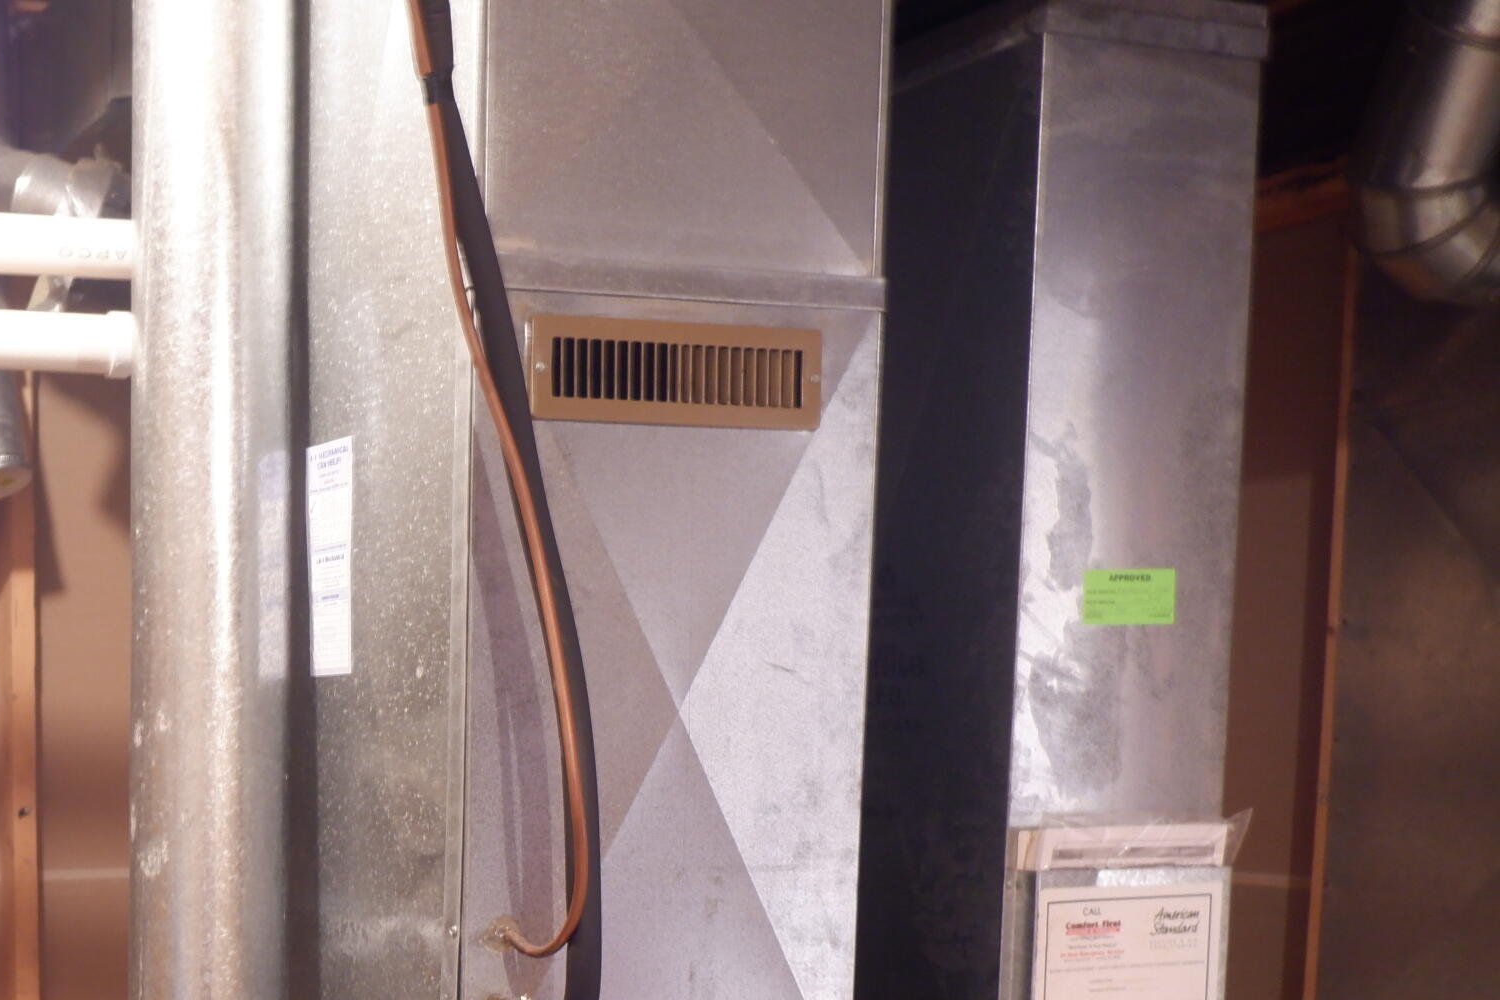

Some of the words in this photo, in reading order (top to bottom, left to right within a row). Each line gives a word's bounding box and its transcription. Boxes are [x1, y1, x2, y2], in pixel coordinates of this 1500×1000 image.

[1108, 573, 1152, 582] APPROVED
[1082, 907, 1102, 917] CALL
[1154, 907, 1200, 922] American
[1066, 921, 1099, 931] Comfort
[1149, 919, 1201, 936] Standard
